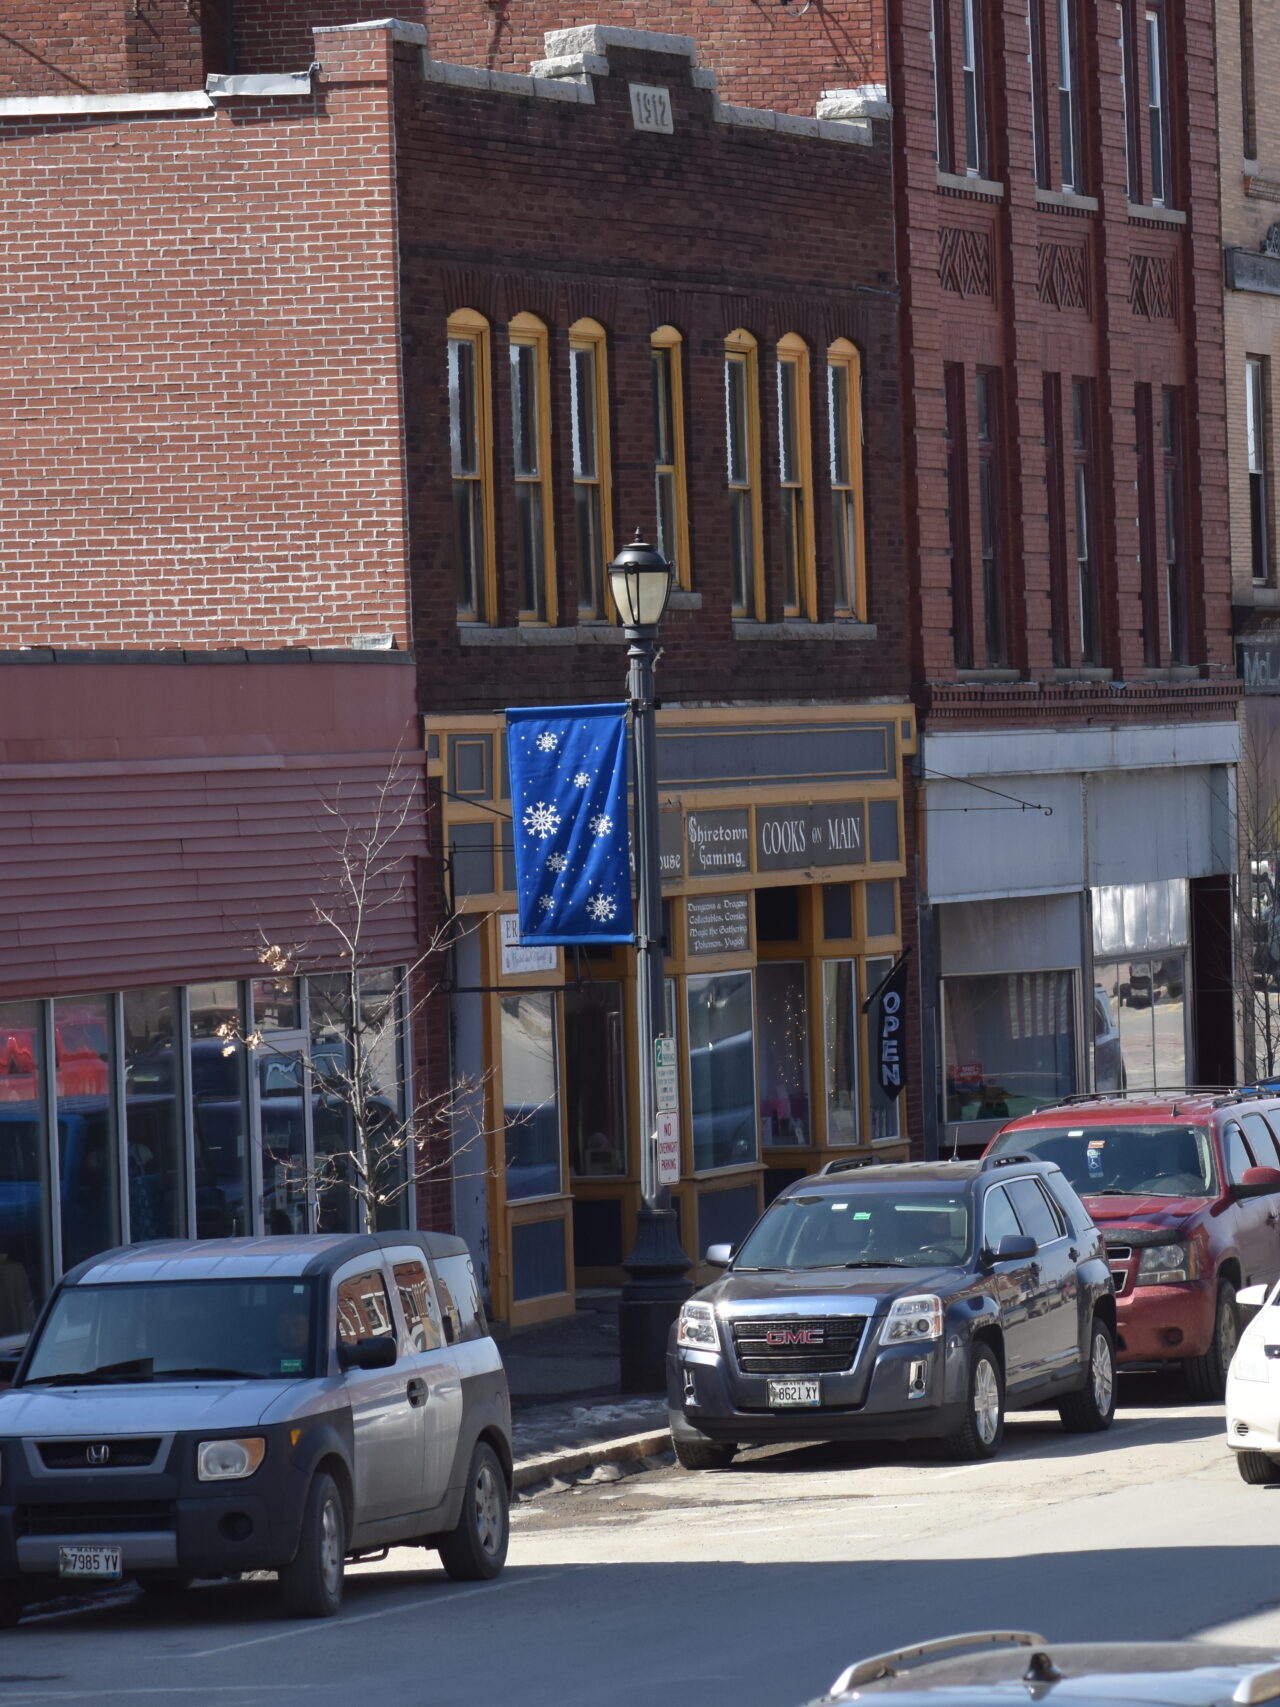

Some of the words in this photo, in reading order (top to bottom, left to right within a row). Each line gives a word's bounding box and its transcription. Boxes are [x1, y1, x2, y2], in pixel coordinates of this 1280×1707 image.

[636, 91, 669, 126] 1912
[688, 815, 748, 846] Shiretown
[762, 820, 806, 855] COOKS
[827, 817, 860, 850] MAIN
[699, 845, 743, 870] Gaming
[724, 899, 748, 909] Dragons
[690, 927, 708, 937] Magic
[719, 925, 748, 936] Gathering
[881, 991, 901, 1086] OPEN
[657, 1045, 662, 1063] 2
[664, 1122, 672, 1137] NO
[659, 1141, 678, 1154] OVERNIGHT
[661, 1158, 677, 1170] PARKING
[766, 1329, 824, 1345] GMC
[779, 1386, 802, 1400] 8621
[805, 1386, 817, 1400] XY
[71, 1554, 100, 1570] 7985
[104, 1554, 118, 1570] YV
